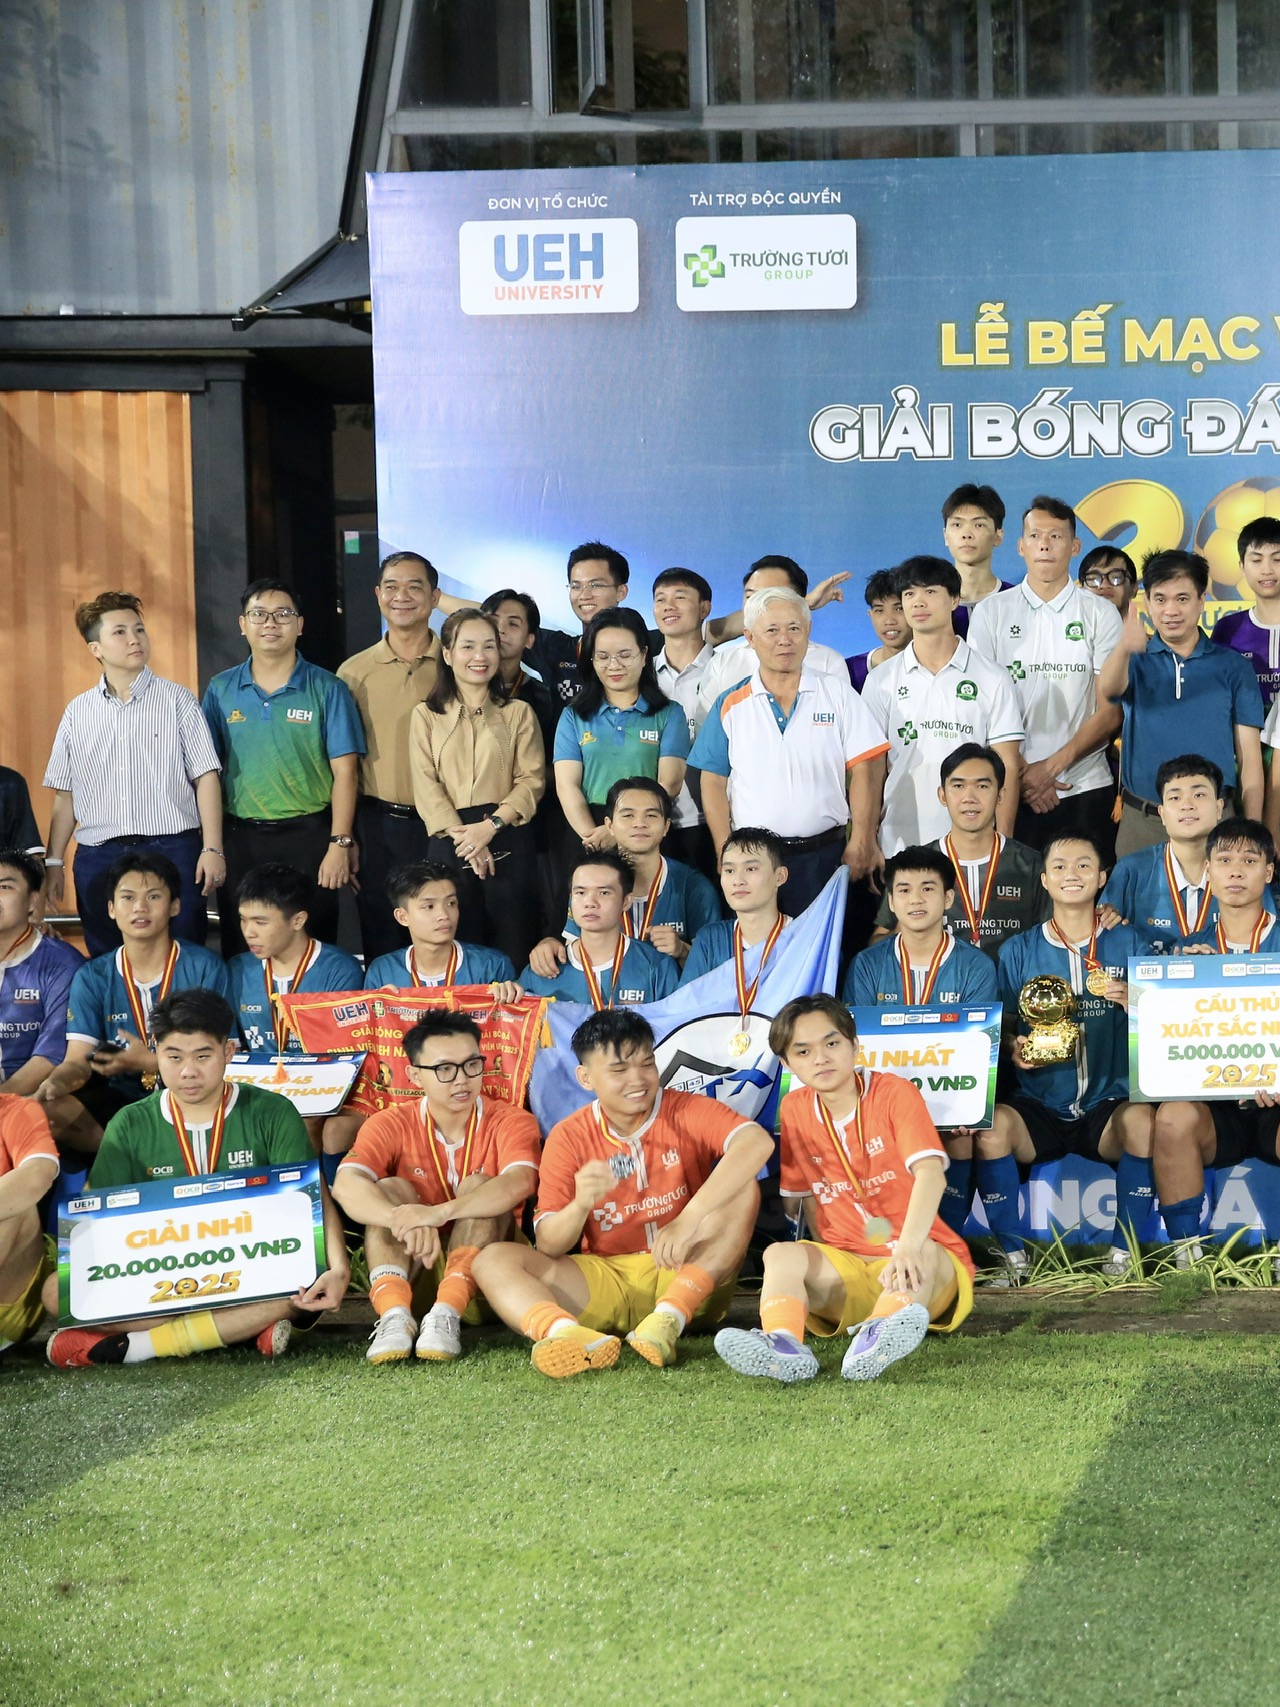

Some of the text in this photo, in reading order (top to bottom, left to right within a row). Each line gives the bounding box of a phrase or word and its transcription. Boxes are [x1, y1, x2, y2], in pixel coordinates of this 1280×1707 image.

[488, 194, 608, 211] ĐƠN VỊ TỔ CHỨC
[690, 187, 841, 208] TÀI TRỢ ĐỘC QUYỀN
[494, 232, 604, 282] UEH
[729, 249, 849, 268] TRƯỜNG TƯƠI
[764, 269, 813, 281] GROUP
[494, 284, 604, 301] UNIVERSITY
[940, 302, 1010, 367] LỄ
[1028, 303, 1113, 365] BẾ
[1124, 314, 1261, 374] MẠC
[809, 384, 953, 462] GIẢI
[968, 386, 1175, 460] BÓNG
[1029, 662, 1086, 673] TRƯỜNG TƯƠI
[287, 708, 313, 721] UEH
[812, 713, 835, 723] UEH
[933, 730, 959, 739] GROUP
[953, 721, 974, 735] TƯƠI
[997, 886, 1021, 898] UEH
[997, 918, 1021, 929] TƯƠI
[1154, 917, 1171, 926] OCB
[1141, 967, 1158, 976] UEH
[14, 989, 40, 1000] UEH
[619, 989, 645, 1001] UEH
[246, 1004, 262, 1012] OCB
[1194, 991, 1280, 1014] CẦU THỦ
[111, 1012, 128, 1020] OCB
[333, 1002, 369, 1022] UEH
[351, 1024, 374, 1038] GIẢI
[1161, 1017, 1214, 1038] XUẤT
[1217, 1013, 1258, 1036] SẮC
[881, 1042, 955, 1067] NHẤT
[1168, 1042, 1266, 1061] 5.000.000
[1202, 1064, 1277, 1085] 2025
[690, 1079, 701, 1088] 45
[927, 1076, 977, 1092] VNĐ
[285, 1086, 345, 1096] THANH
[228, 1151, 253, 1165] UEH
[153, 1166, 173, 1175] OCB
[183, 1186, 200, 1194] OCB
[74, 1200, 95, 1209] UEH
[125, 1211, 253, 1250] GIẢI NHÌ
[87, 1236, 302, 1282] 20.000.000 VNĐ
[151, 1270, 242, 1299] 2025
